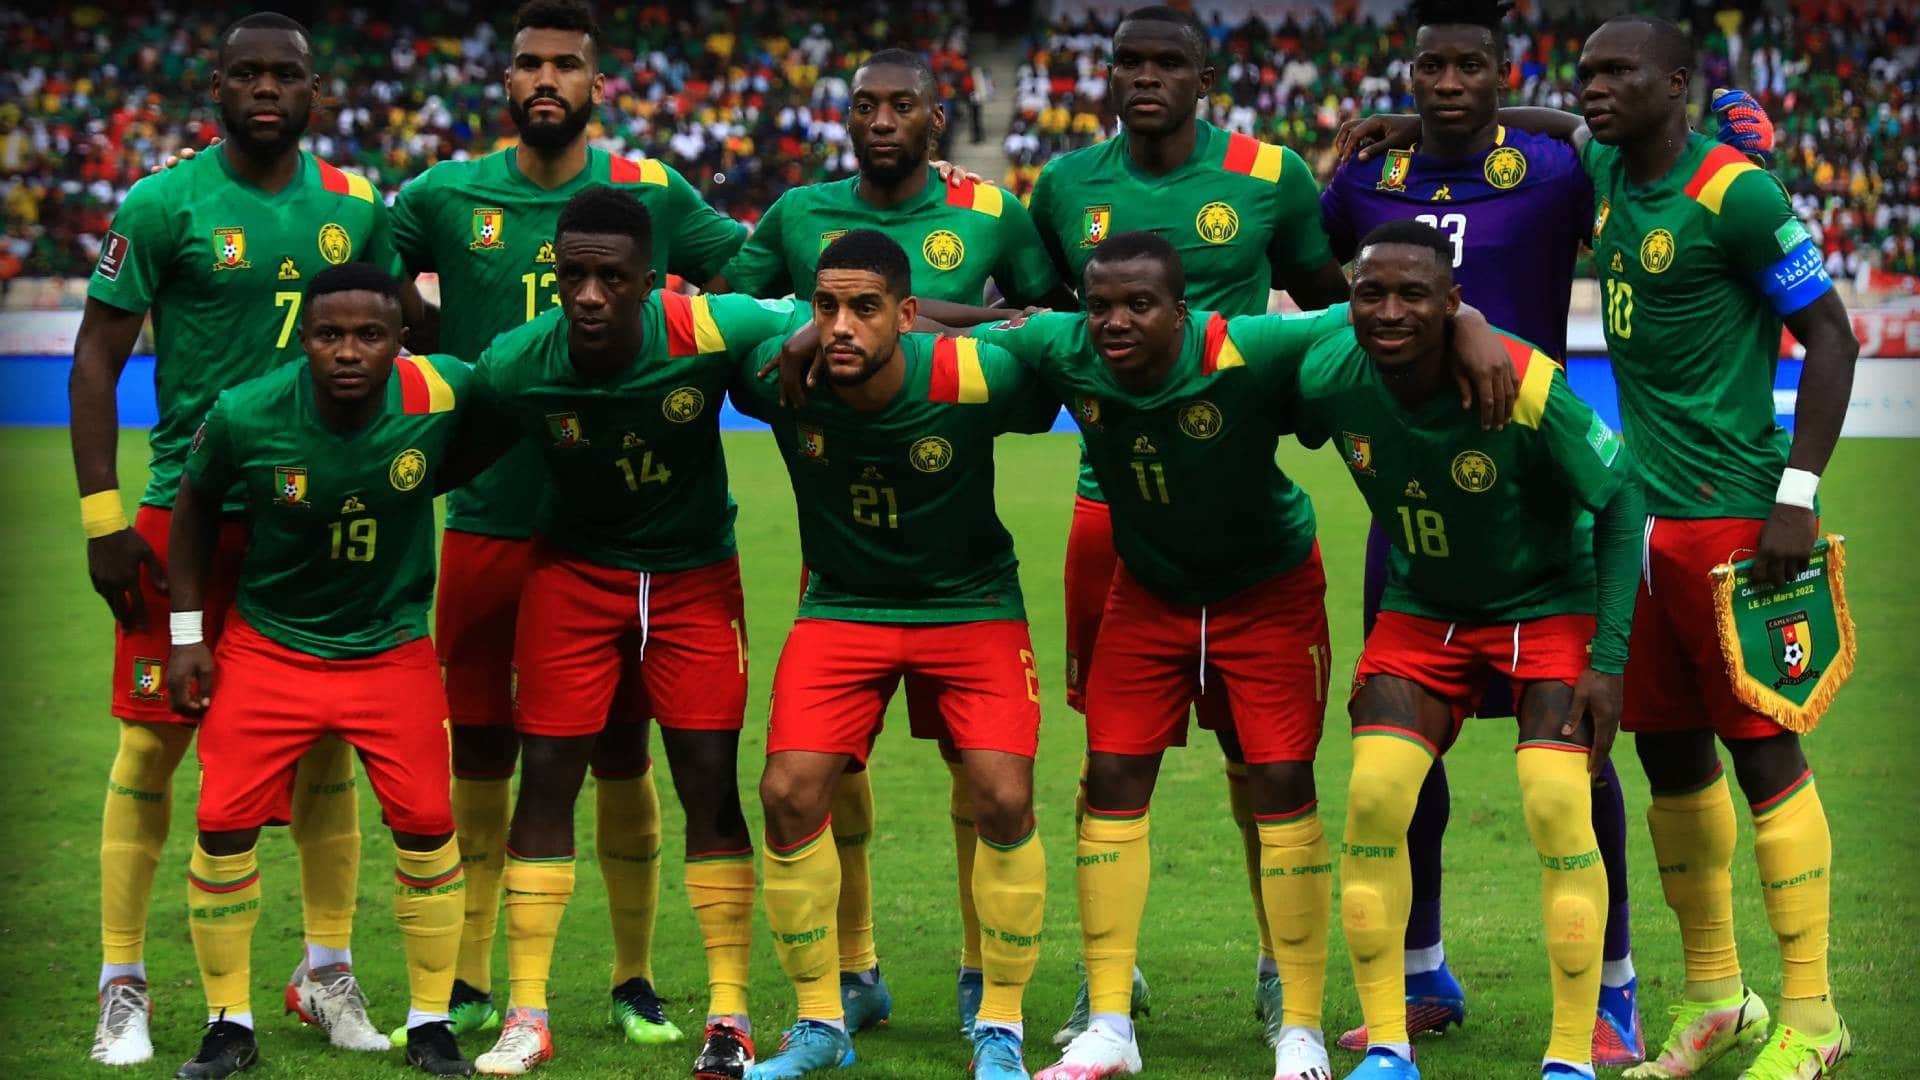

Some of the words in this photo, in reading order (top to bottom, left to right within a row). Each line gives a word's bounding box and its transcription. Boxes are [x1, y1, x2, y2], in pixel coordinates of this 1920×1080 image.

[275, 291, 302, 348] 7
[1606, 278, 1634, 340] 10
[615, 450, 673, 491] 14
[1130, 461, 1170, 504] 11
[849, 484, 898, 529] 21
[327, 518, 377, 562] 19
[1396, 505, 1450, 558] 18
[1747, 599, 1761, 610] LE
[1761, 596, 1773, 607] 25
[1773, 591, 1795, 603] Mars
[1794, 583, 1815, 597] 2022
[1350, 844, 1397, 858] SPORTIF
[212, 897, 259, 919] SPORTIF
[781, 925, 828, 944] SPORTIF
